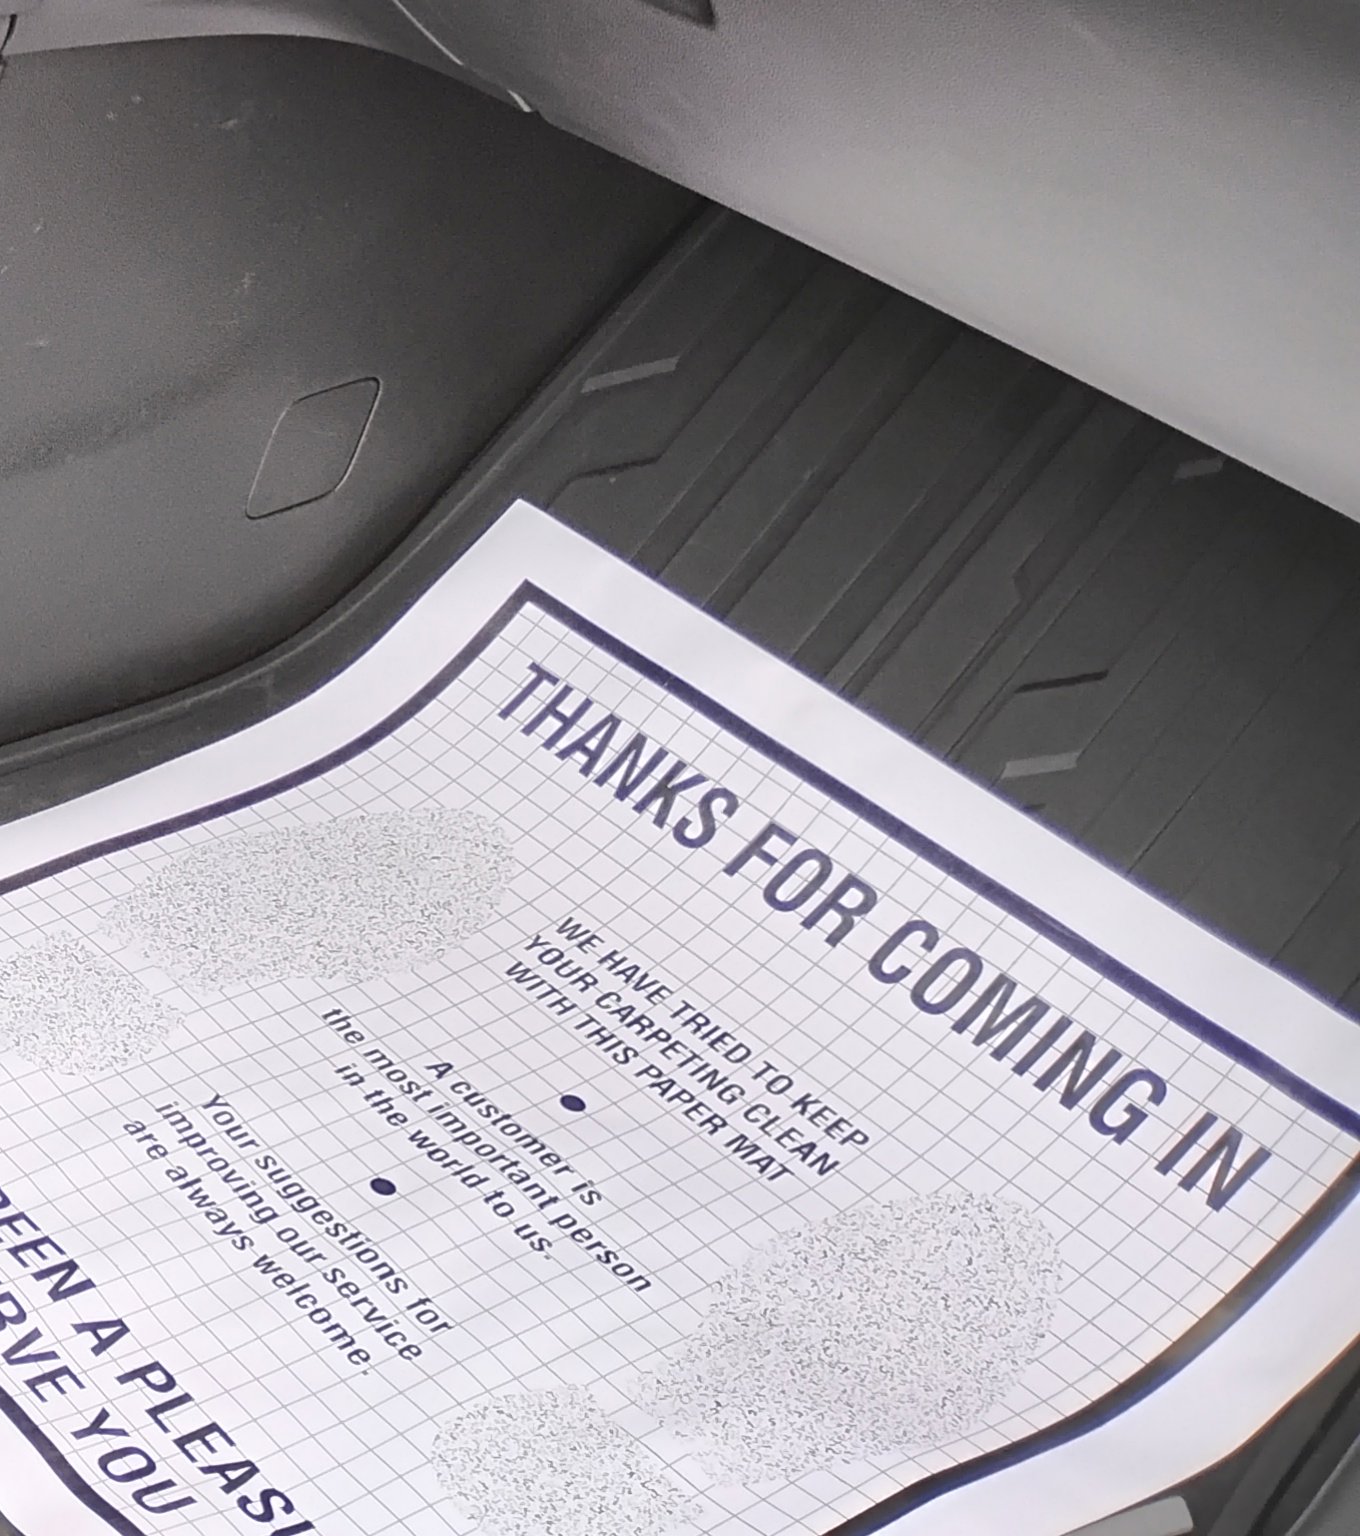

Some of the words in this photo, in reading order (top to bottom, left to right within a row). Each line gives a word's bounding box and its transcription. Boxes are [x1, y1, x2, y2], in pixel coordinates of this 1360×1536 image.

[496, 662, 739, 848] THANKS
[723, 821, 878, 948] FOR
[868, 918, 1167, 1145] COMING
[1155, 1112, 1272, 1213] IN
[524, 935, 599, 994] YOUR
[595, 991, 746, 1105] CARPETING
[743, 1103, 840, 1176] CLEAN
[556, 917, 604, 954] WE
[598, 949, 674, 1006] HAVE
[670, 1000, 752, 1064] TRIED
[752, 1060, 794, 1095] TO
[791, 1092, 870, 1149] KEEP
[322, 1008, 365, 1044] the
[364, 1048, 433, 1103] most
[428, 1102, 559, 1209] important
[549, 1213, 652, 1292] person
[334, 1063, 365, 1087] in
[363, 1089, 408, 1127] the
[407, 1129, 489, 1190] world
[483, 1190, 515, 1218] to
[514, 1223, 554, 1259] us.
[425, 1062, 454, 1080] A
[450, 1080, 575, 1177] customer
[571, 1180, 603, 1206] is
[505, 961, 578, 1016] WITH
[574, 1014, 639, 1065] THIS
[635, 1064, 728, 1136] PAPER
[724, 1134, 795, 1183] MAT
[123, 1120, 169, 1160] are
[165, 1165, 254, 1252] always
[252, 1254, 372, 1376] welcome.
[155, 1101, 280, 1225] improving
[276, 1227, 328, 1264] our
[322, 1267, 422, 1361] service
[202, 1094, 260, 1151] Your
[255, 1154, 409, 1294] suggestions
[406, 1297, 455, 1334] for
[70, 1407, 198, 1513] YOU
[71, 1318, 131, 1356] A
[116, 1361, 316, 1536] PLEAS
